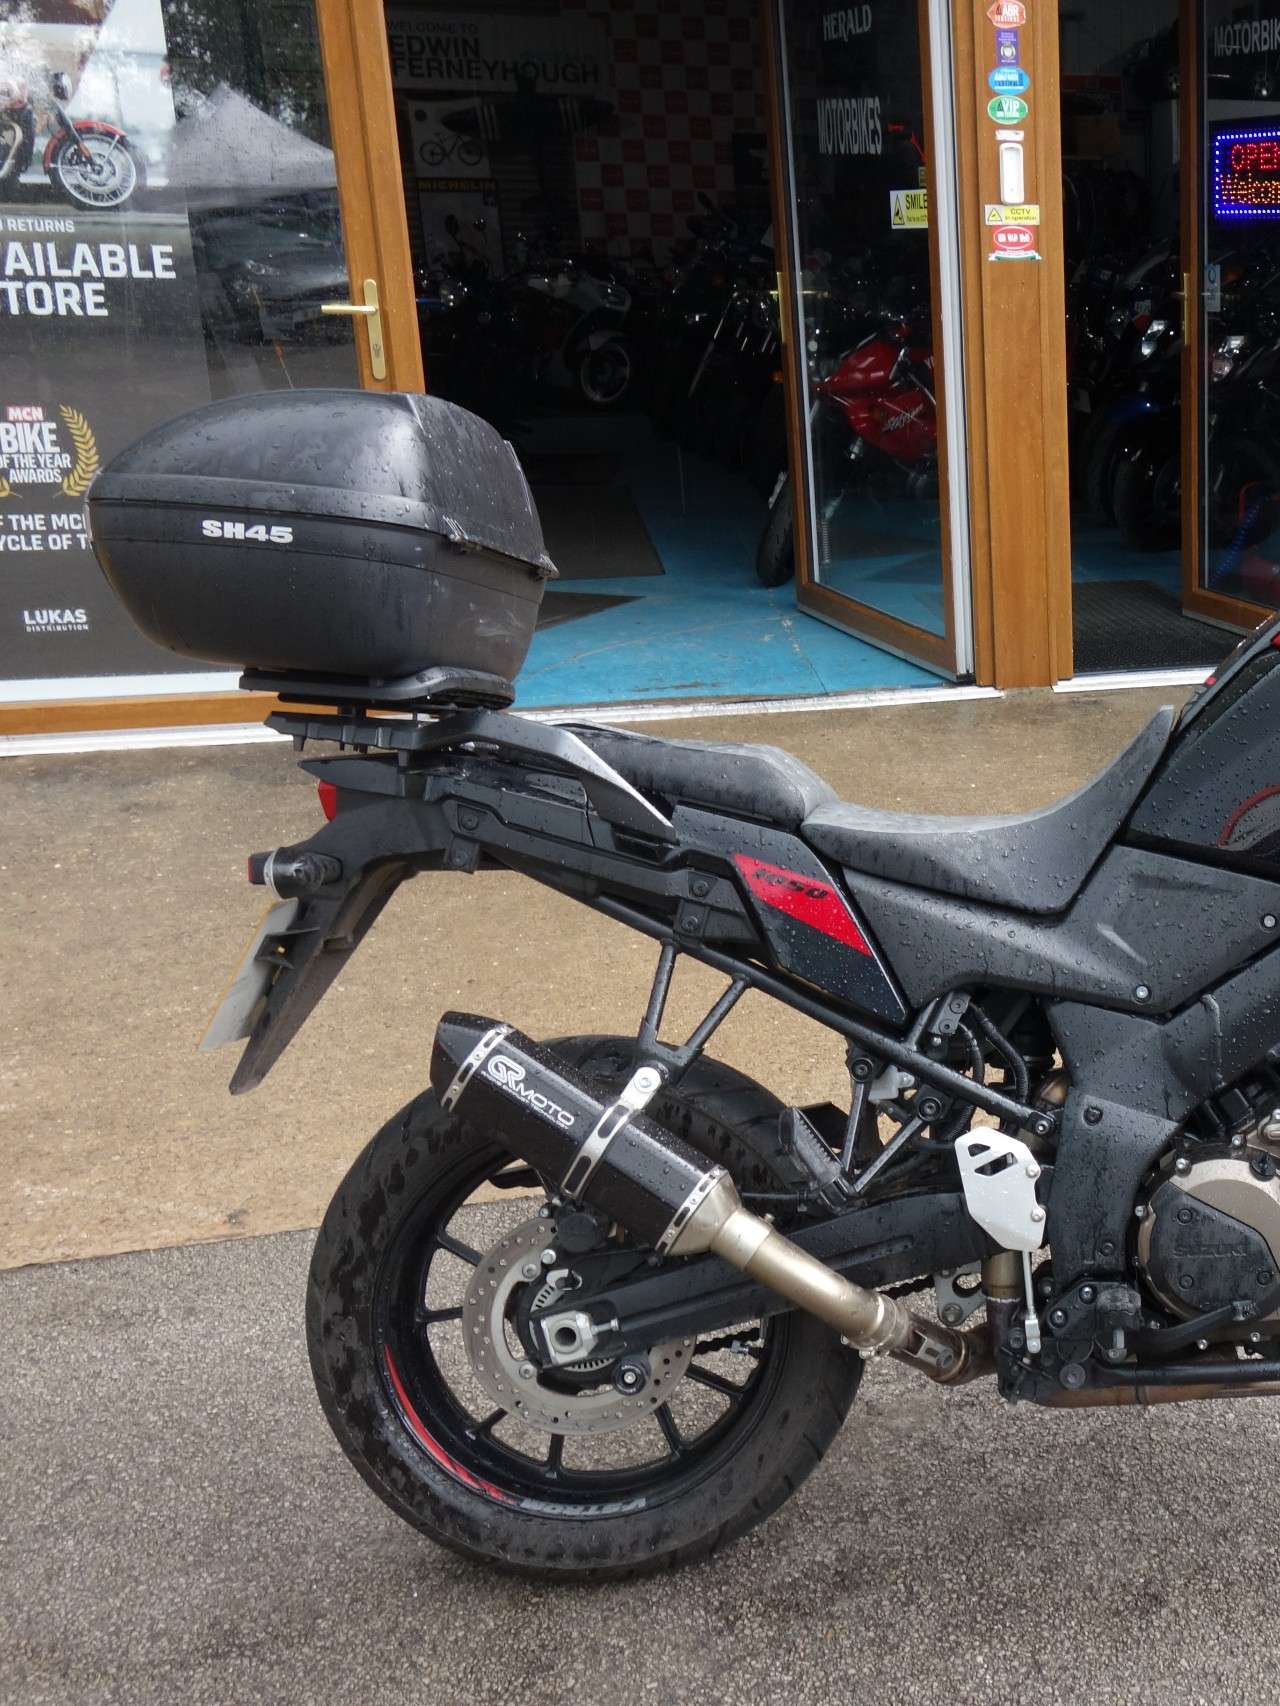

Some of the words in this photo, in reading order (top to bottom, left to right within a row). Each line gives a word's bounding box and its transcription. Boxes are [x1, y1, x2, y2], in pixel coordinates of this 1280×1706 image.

[823, 4, 872, 41] HERALD
[392, 35, 480, 58] EDWIN
[393, 57, 600, 84] FERNEYHOUGH
[817, 95, 882, 155] MOTORBIKES
[7, 218, 75, 233] RETURNS
[5, 241, 177, 279] AILABLE
[8, 406, 44, 421] MCN
[0, 421, 60, 454] BIKE
[12, 454, 37, 469] THE
[37, 453, 72, 469] YEAR
[9, 468, 63, 484] AWARDS
[8, 514, 46, 531] THE
[202, 519, 294, 544] SH45
[48, 533, 72, 550] OF
[24, 608, 87, 625] LUKAS
